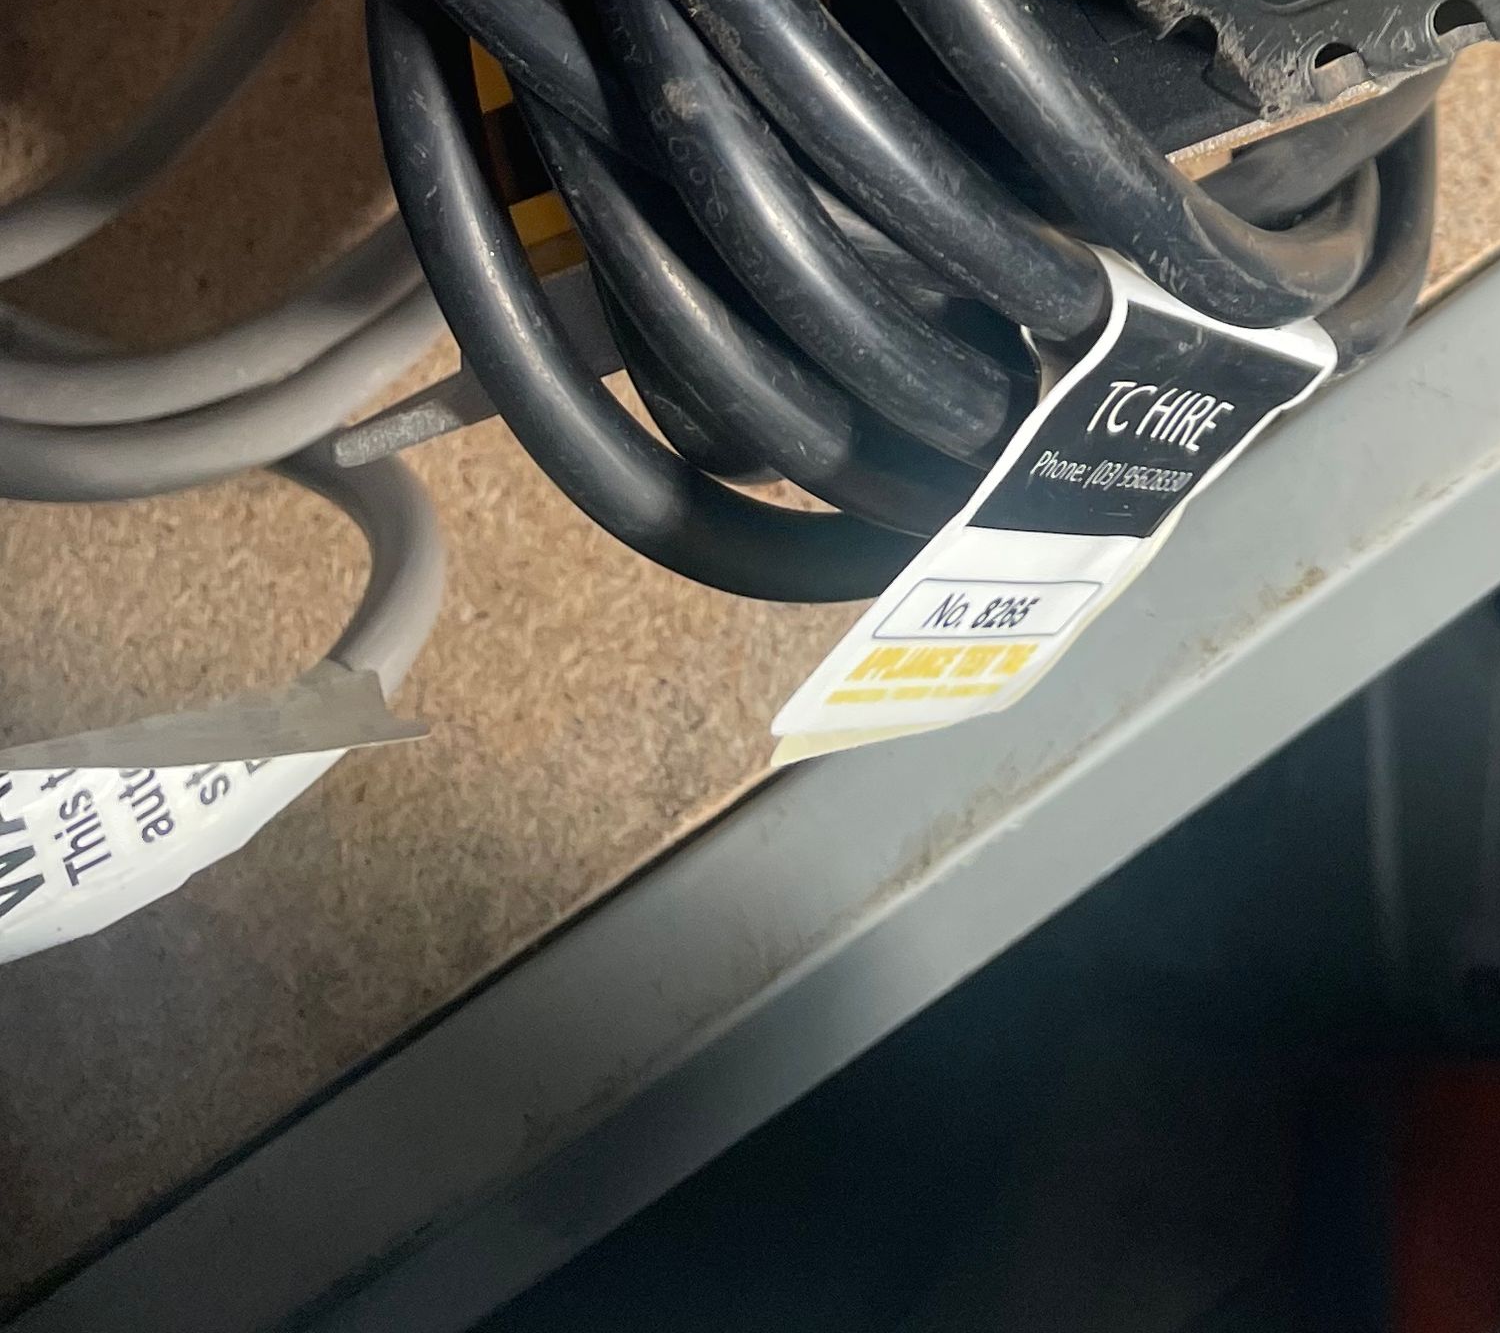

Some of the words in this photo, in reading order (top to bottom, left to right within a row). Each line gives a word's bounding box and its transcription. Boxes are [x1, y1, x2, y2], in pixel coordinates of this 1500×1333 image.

[1087, 381, 1159, 433] TC
[1135, 387, 1235, 452] HIRE
[1030, 450, 1092, 483] Phone:
[1083, 459, 1129, 491] (03)
[921, 592, 971, 629] No.
[970, 596, 1042, 630] 8265
[54, 789, 112, 887] This
